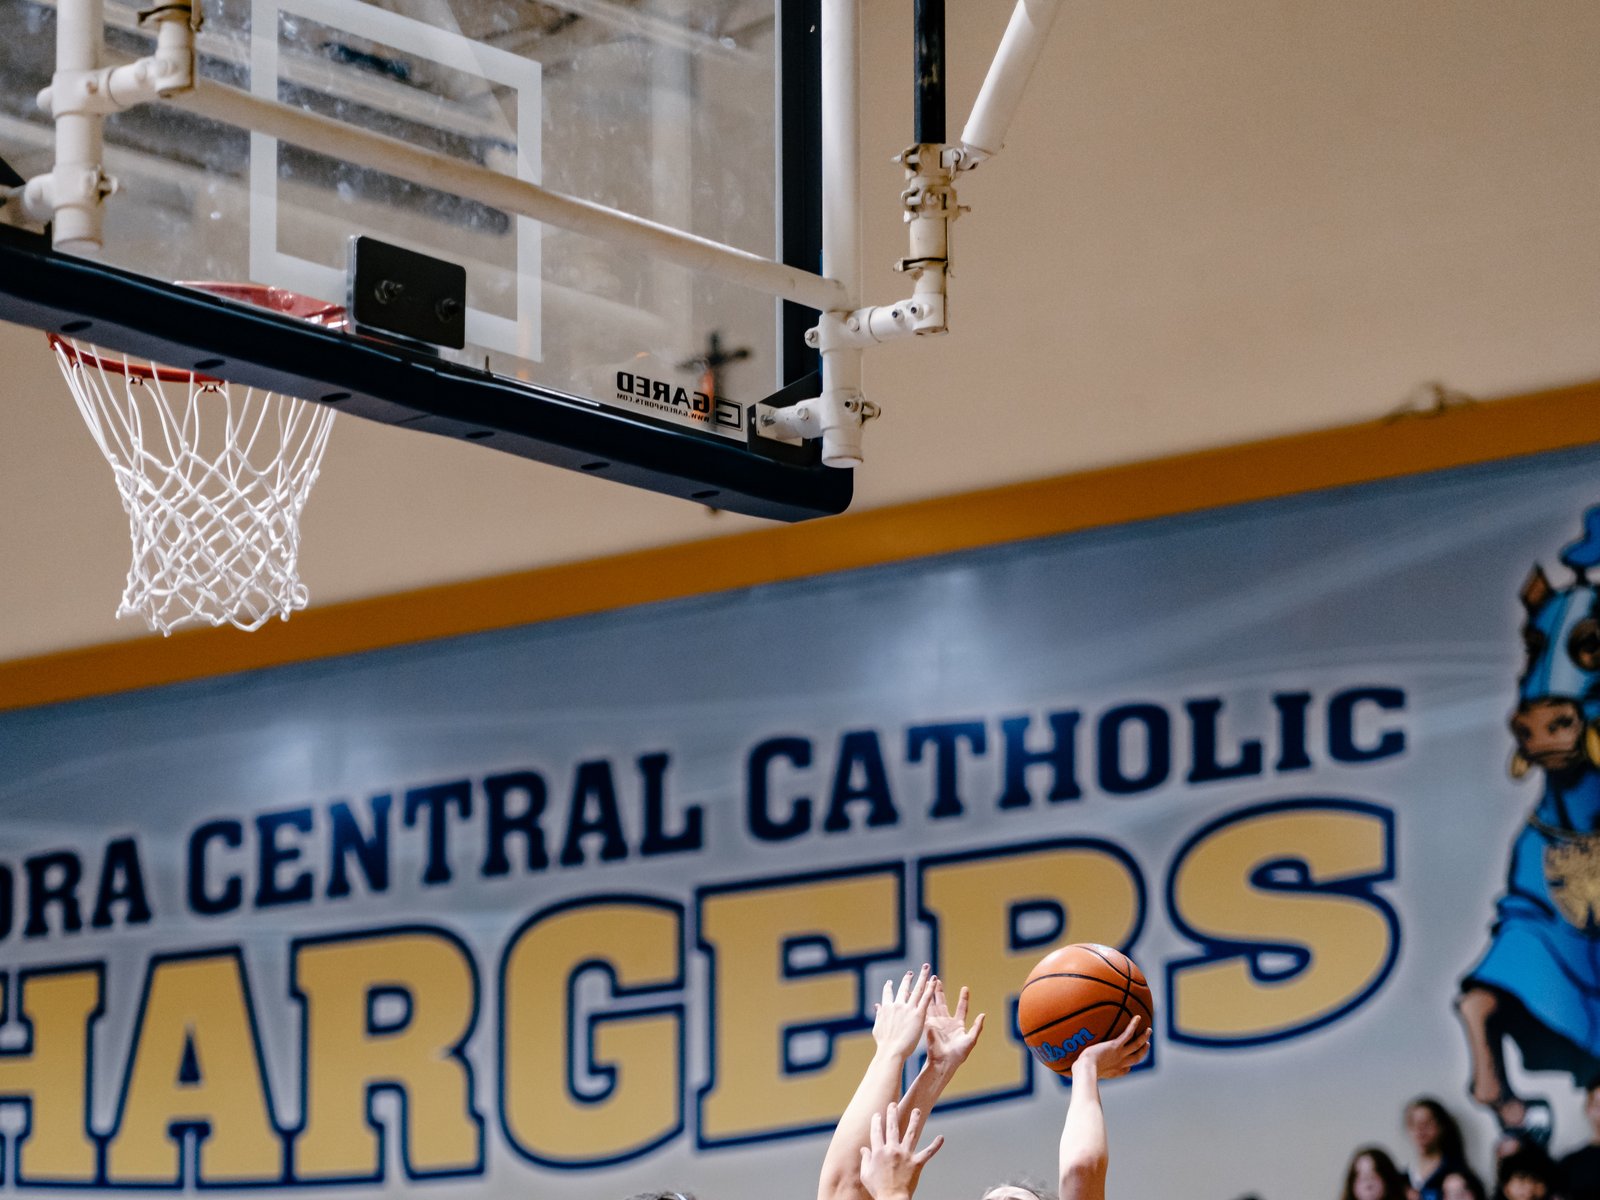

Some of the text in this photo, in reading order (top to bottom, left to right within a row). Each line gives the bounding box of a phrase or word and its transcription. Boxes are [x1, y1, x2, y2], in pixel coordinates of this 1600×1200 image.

[0, 686, 1407, 941] RA CENTRAL CATHOLIC
[1029, 1028, 1096, 1063] ilson
